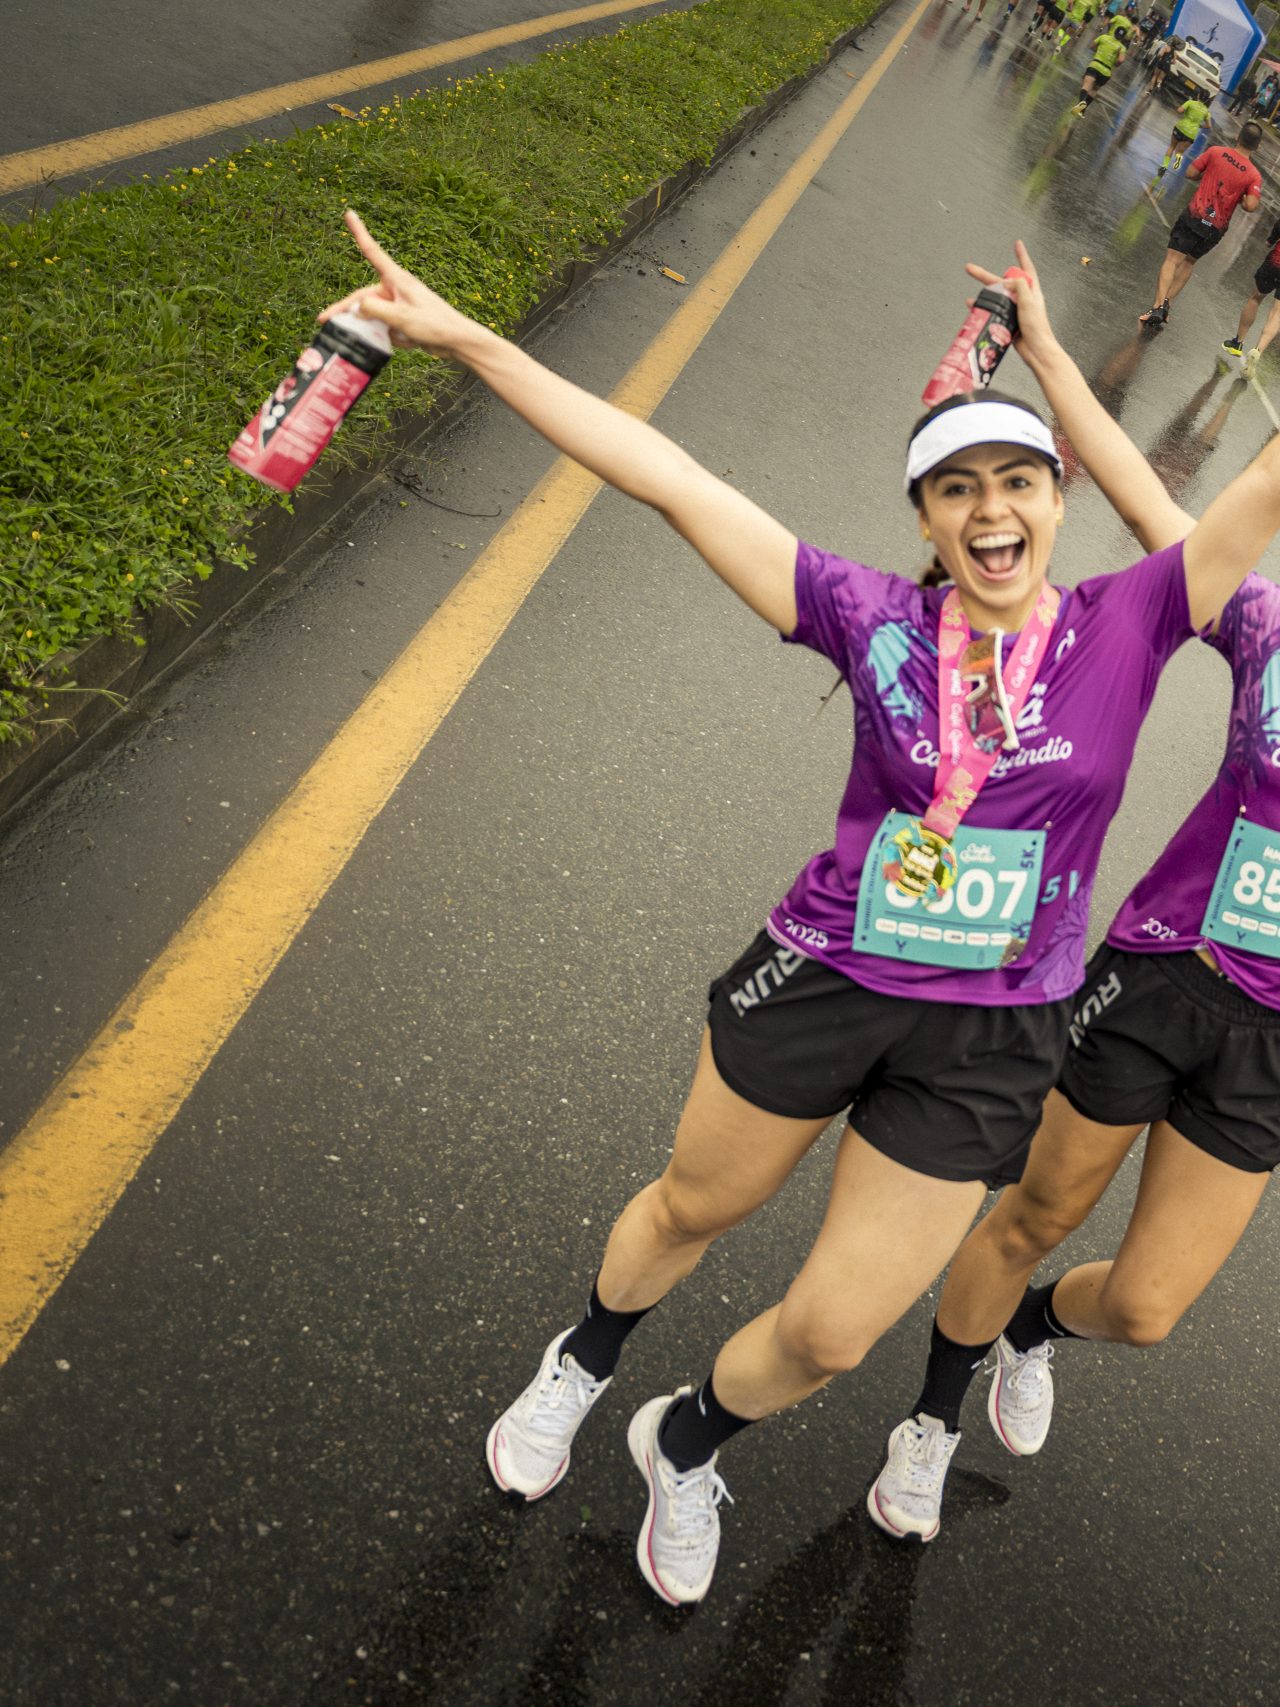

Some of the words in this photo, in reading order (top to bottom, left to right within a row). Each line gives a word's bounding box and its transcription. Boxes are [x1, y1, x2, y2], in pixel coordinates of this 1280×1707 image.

[1222, 152, 1247, 173] POLLO
[910, 739, 941, 768] Ca
[784, 918, 830, 949] 2025
[1141, 917, 1179, 941] 2025
[729, 949, 805, 1019] RUN
[1069, 971, 1123, 1048] RUN
